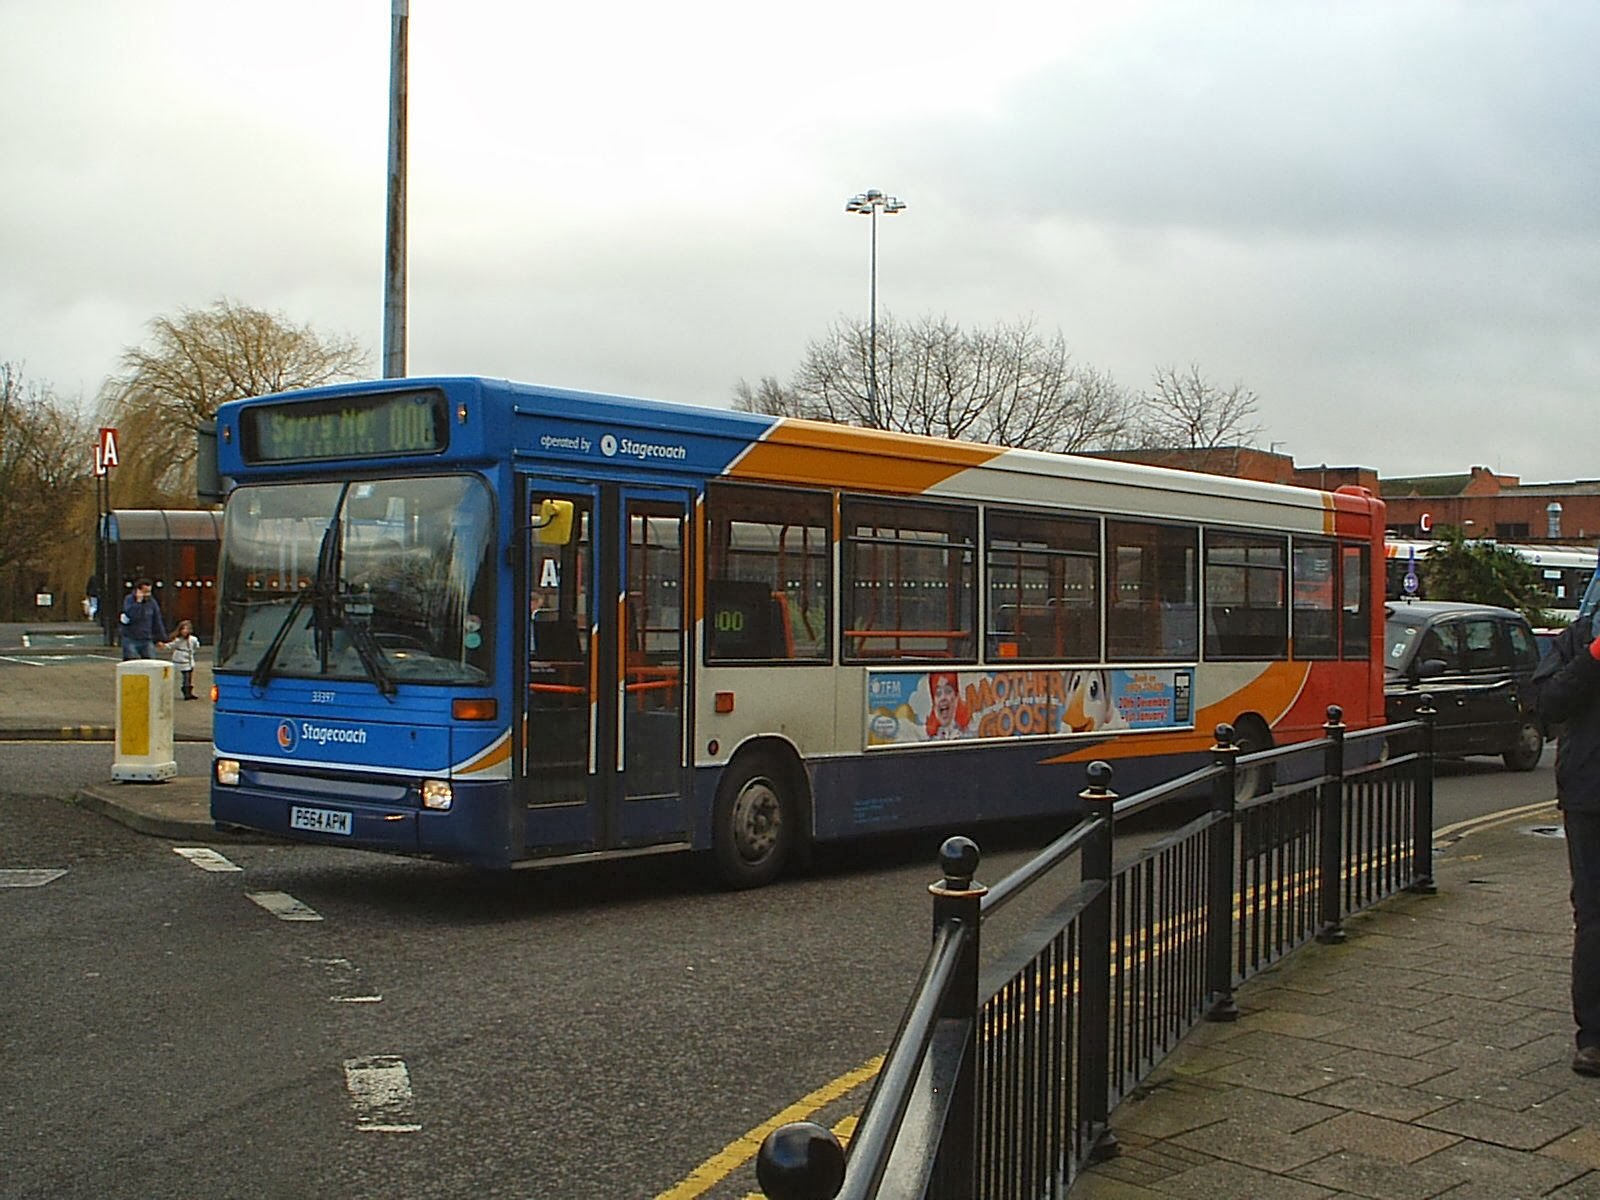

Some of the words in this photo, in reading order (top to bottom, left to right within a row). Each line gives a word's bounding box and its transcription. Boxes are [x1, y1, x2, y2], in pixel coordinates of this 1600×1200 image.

[103, 431, 118, 465] A
[540, 434, 579, 449] operated
[580, 437, 592, 452] by
[620, 438, 686, 460] Stagecoach
[1420, 513, 1431, 531] C
[540, 558, 558, 587] A
[964, 670, 1066, 718] MOTHER
[302, 723, 367, 746] Stagecoach
[978, 703, 1060, 738] GOOSE
